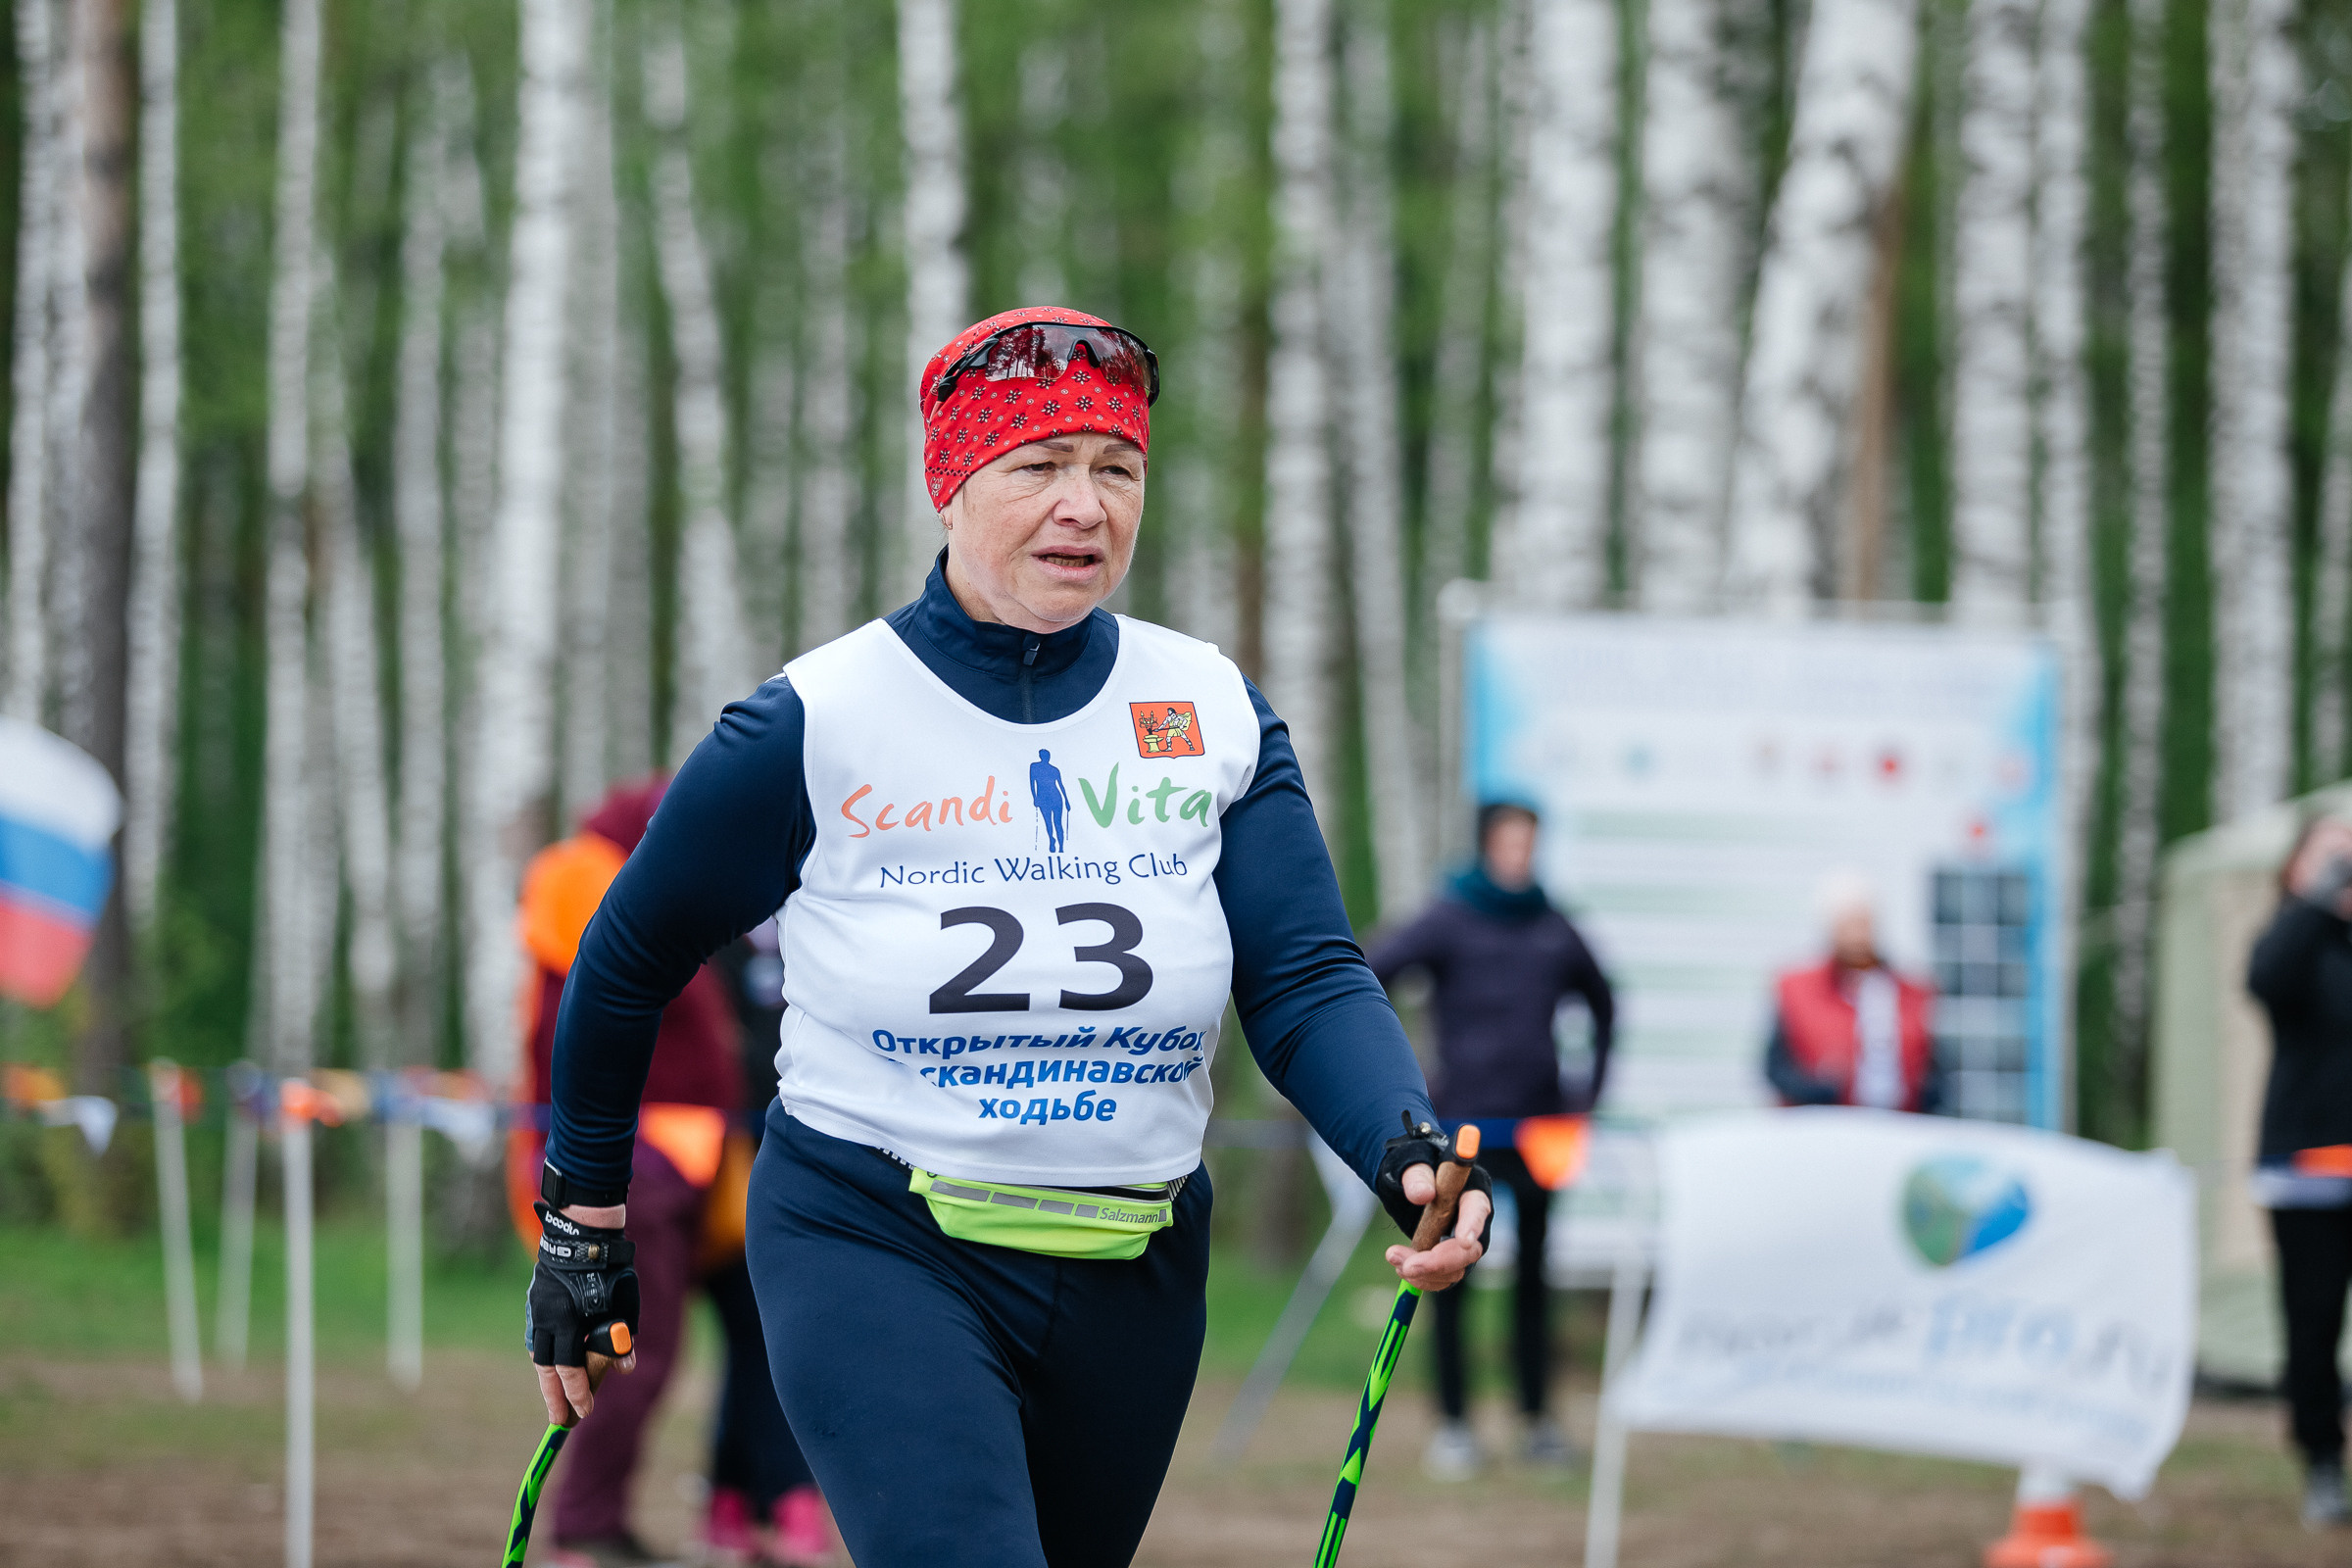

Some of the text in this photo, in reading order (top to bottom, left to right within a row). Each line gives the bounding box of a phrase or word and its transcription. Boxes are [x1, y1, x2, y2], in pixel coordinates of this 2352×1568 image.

[841, 761, 1212, 838] Scandi Vita
[880, 852, 1188, 888] Nordic Walking Club
[929, 902, 1153, 1014] 23
[872, 1026, 1097, 1056] Открытый
[979, 1090, 1117, 1126] ходьбе
[1100, 1206, 1159, 1224] Salzmann
